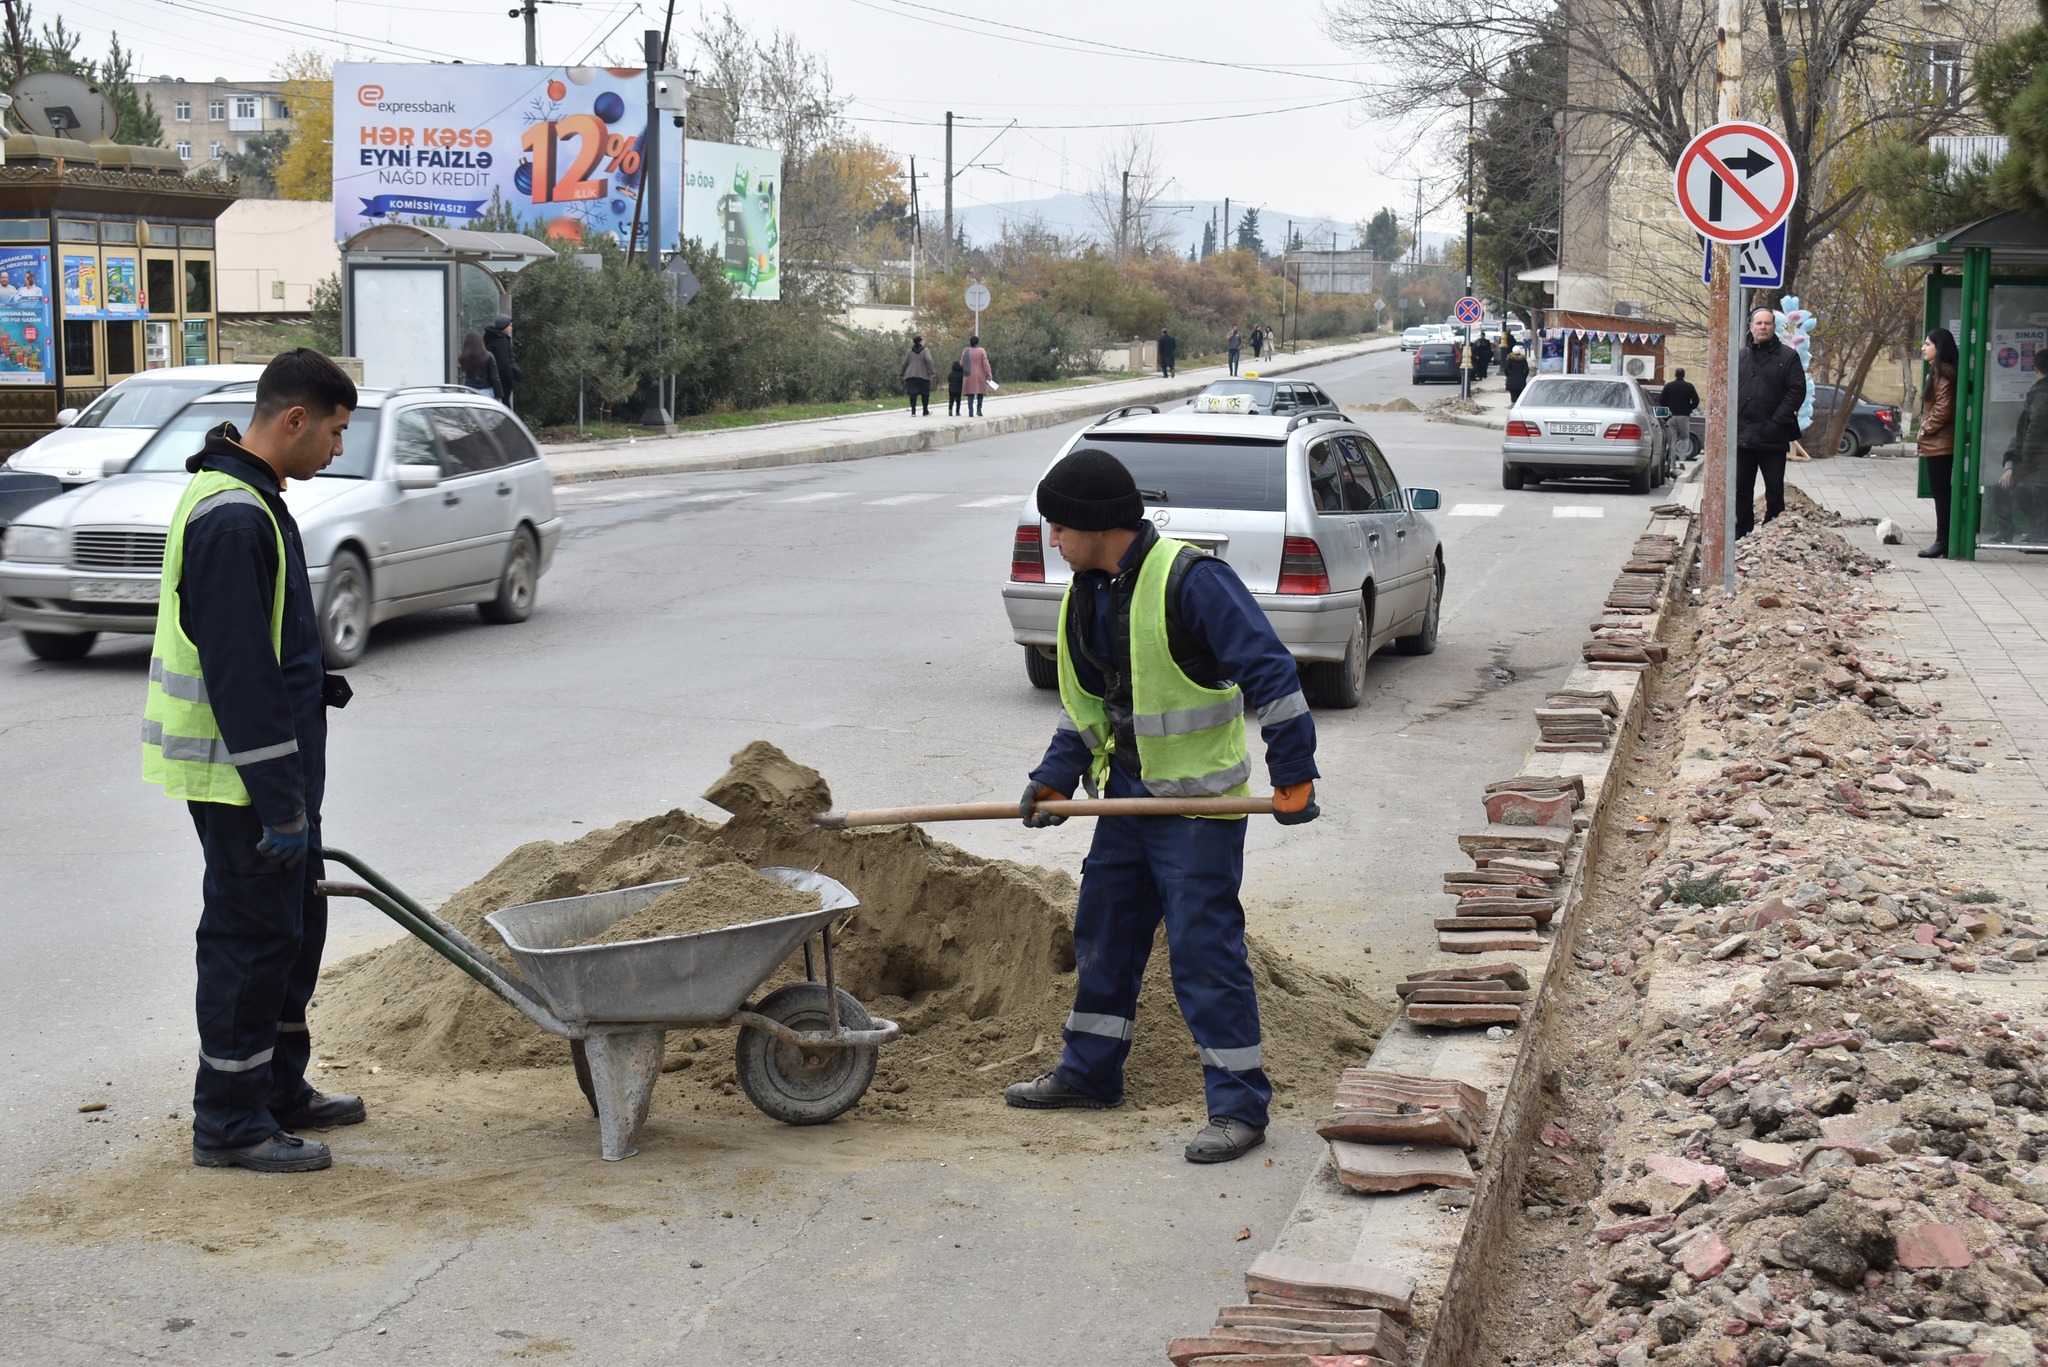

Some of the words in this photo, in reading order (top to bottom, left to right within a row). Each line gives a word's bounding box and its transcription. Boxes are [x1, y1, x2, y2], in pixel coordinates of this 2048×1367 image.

[378, 101, 456, 114] expressbank
[360, 126, 415, 146] HƏR
[423, 128, 493, 148] KƏSƏ
[360, 145, 410, 167] EYNİ
[417, 146, 493, 169] FAİZLƏ
[521, 113, 641, 204] 12%
[379, 168, 427, 185] NAĞD
[432, 170, 490, 187] KREDİT
[685, 173, 696, 187] LƏ
[697, 171, 715, 189] ÖDƏ
[574, 187, 598, 198] İLLİK
[389, 200, 467, 214] KOMİSSİYASIZ!
[2015, 331, 2044, 340] SINAQ
